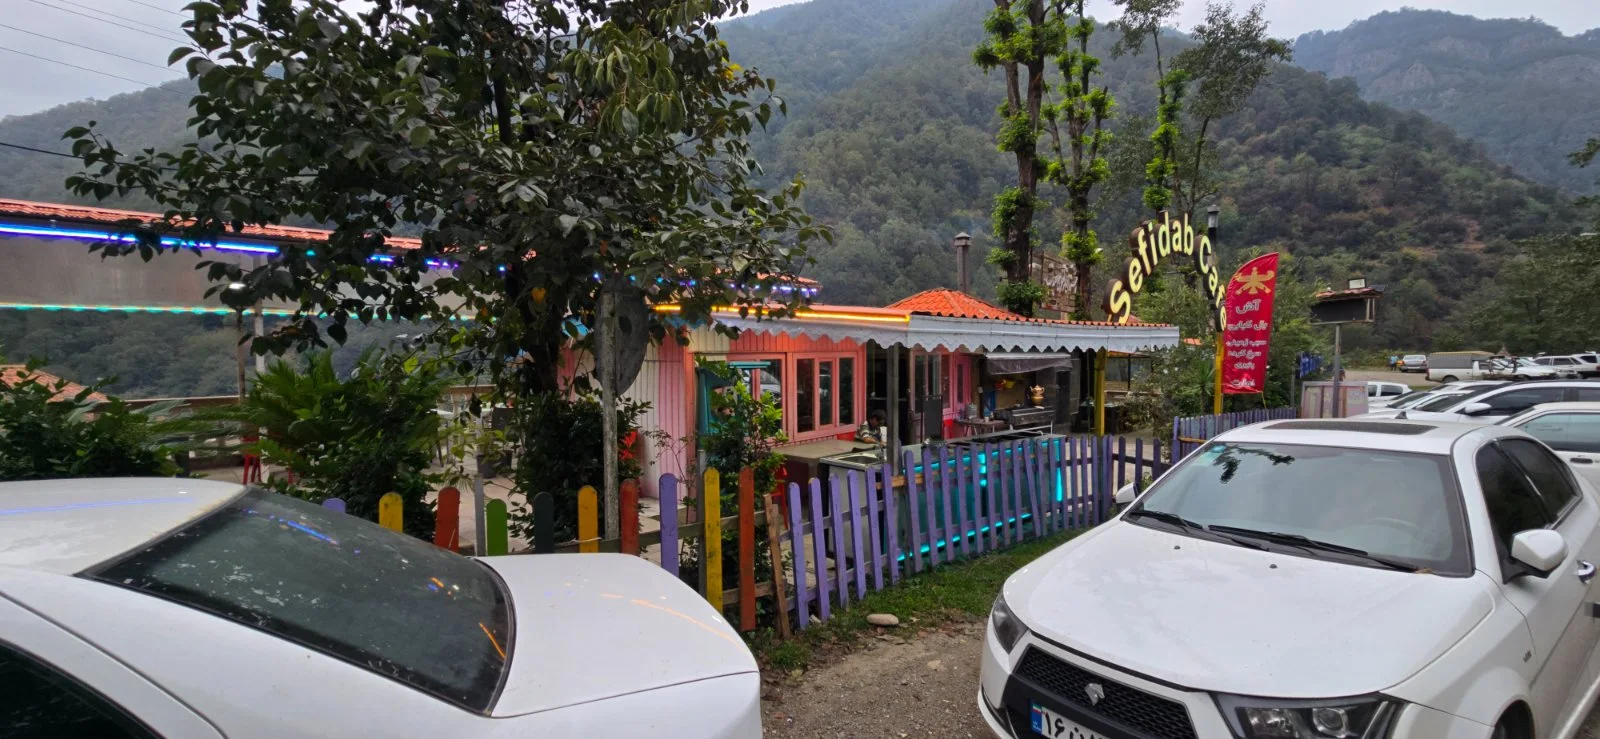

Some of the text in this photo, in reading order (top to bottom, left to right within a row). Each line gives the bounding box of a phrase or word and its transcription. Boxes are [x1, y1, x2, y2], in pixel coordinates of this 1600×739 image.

[1108, 211, 1227, 331] Sefidab Cafe
[1236, 299, 1261, 314] آش
[1226, 338, 1249, 347] زمینی
[1246, 349, 1262, 359] سرخ
